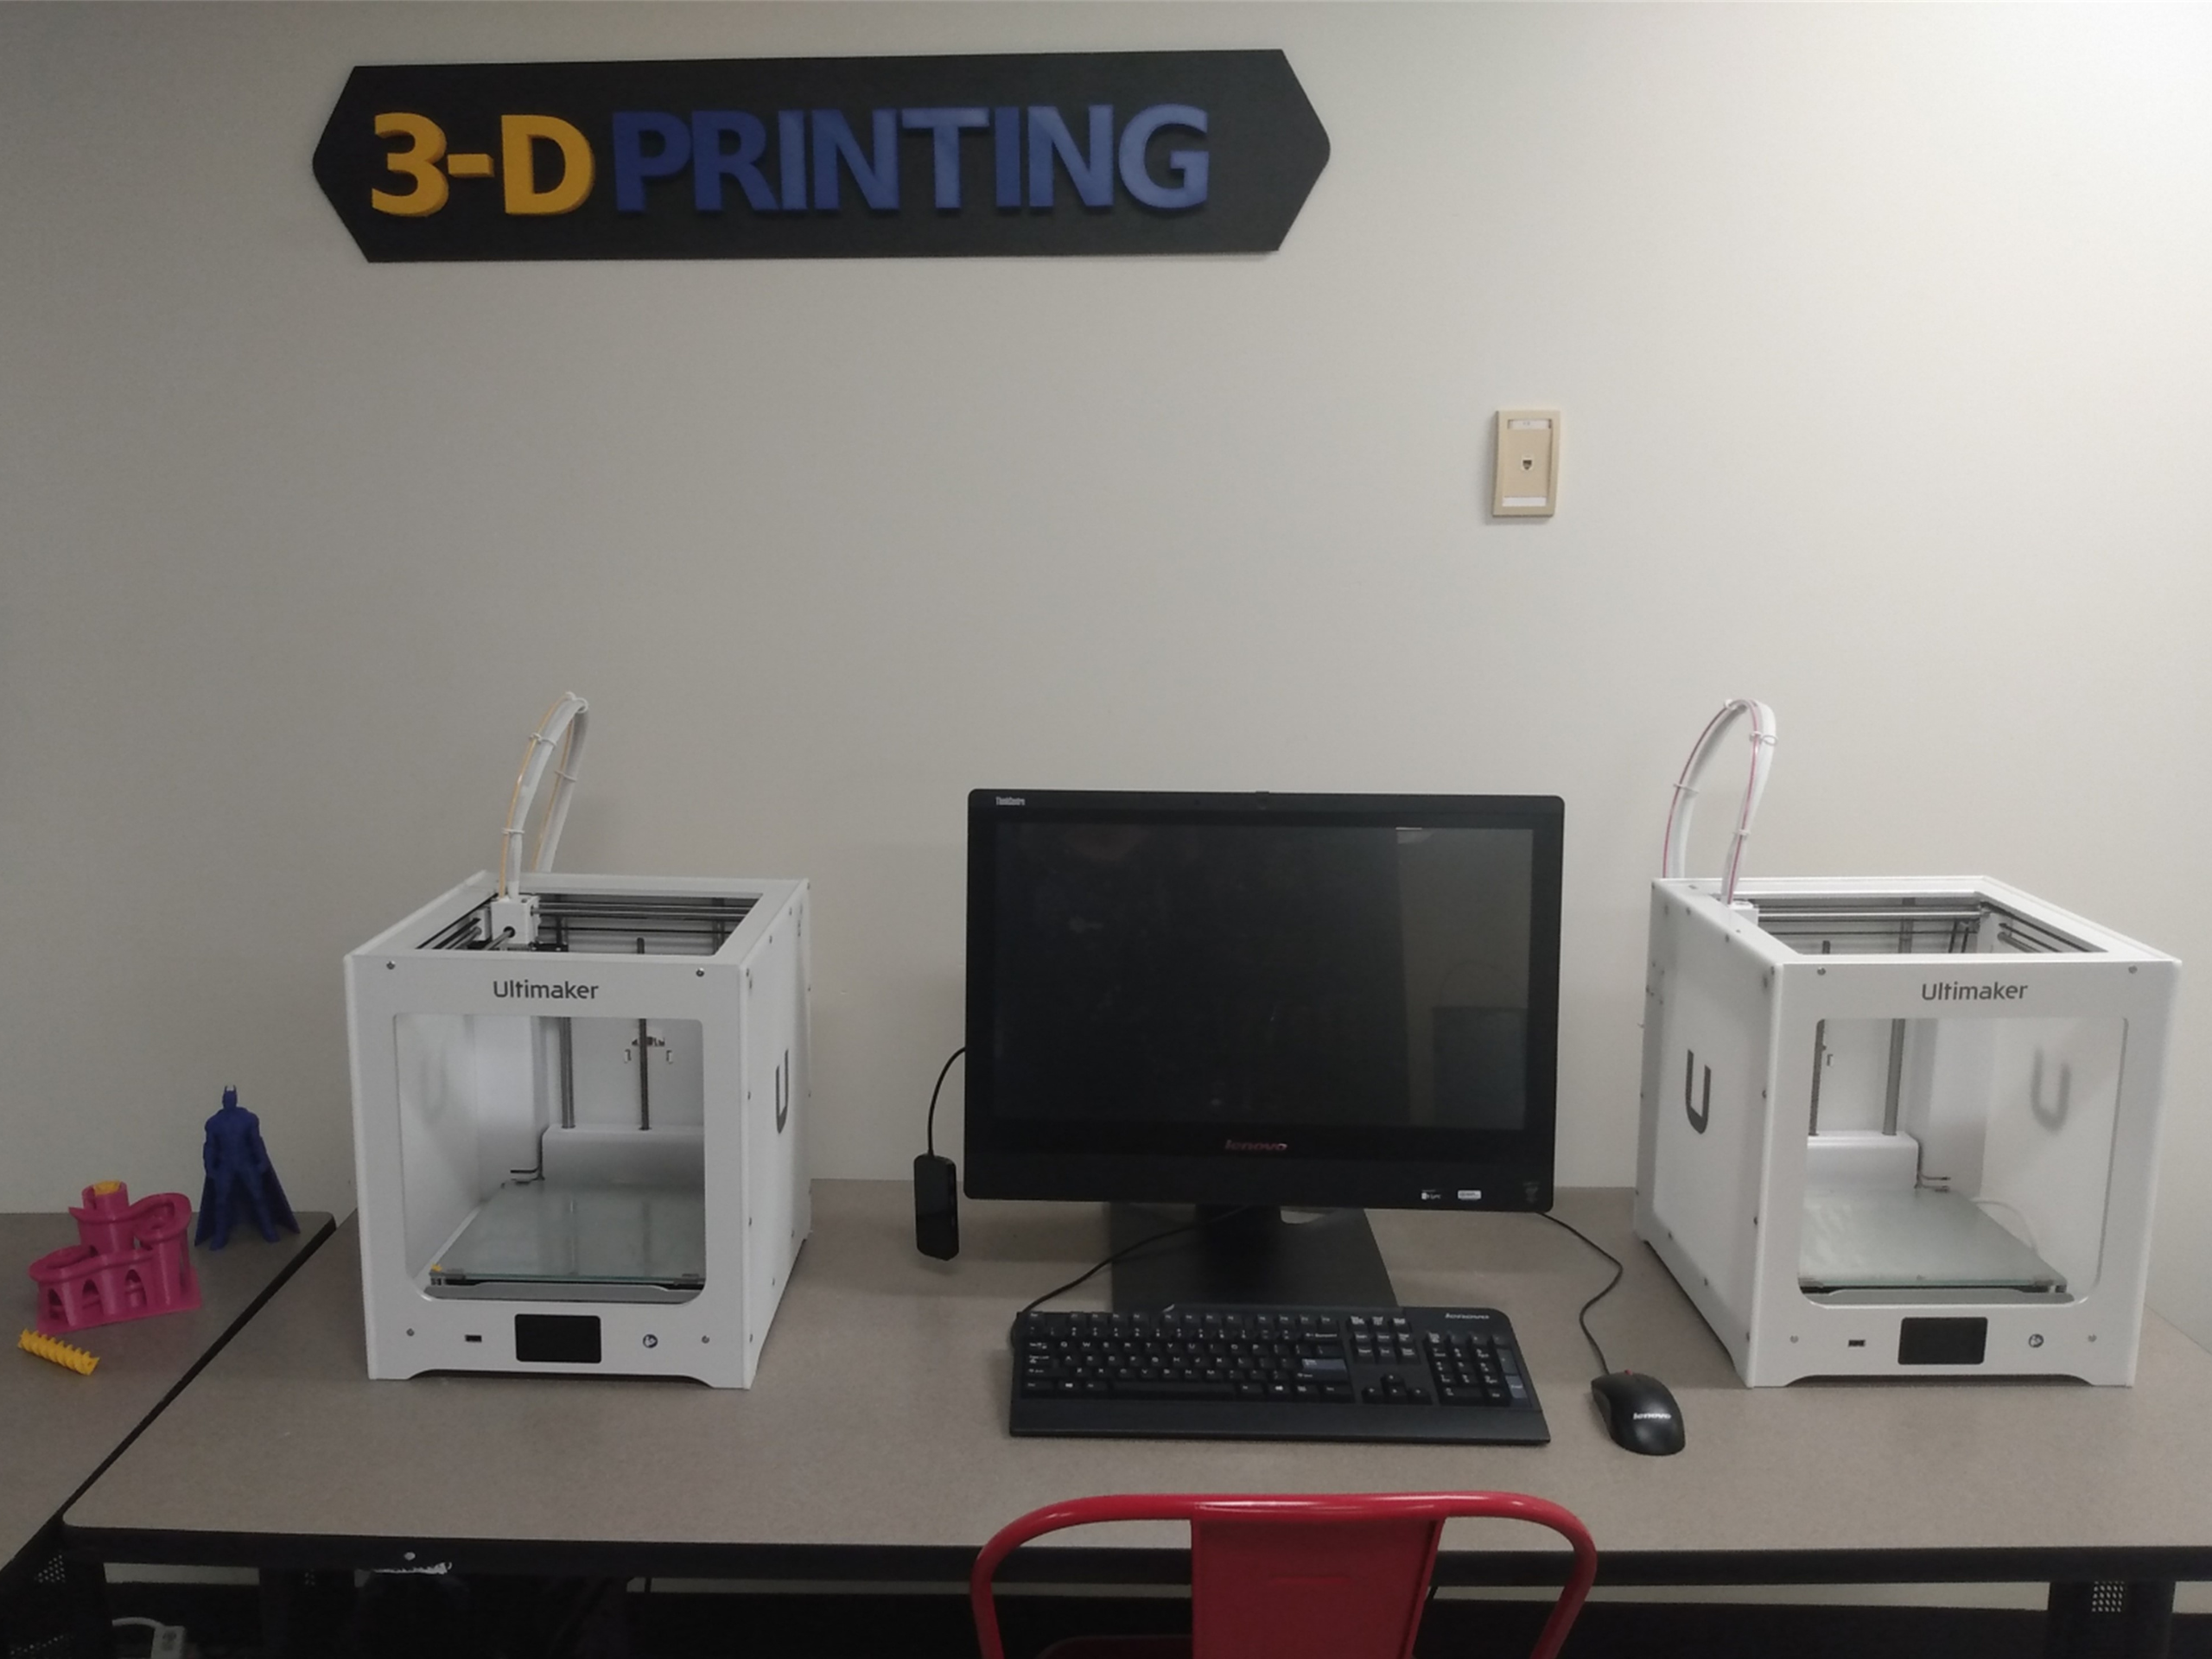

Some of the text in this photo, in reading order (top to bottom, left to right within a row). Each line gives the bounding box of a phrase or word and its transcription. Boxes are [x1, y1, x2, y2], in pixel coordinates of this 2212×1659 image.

[370, 103, 1211, 217] 3-D PRINTING
[493, 979, 600, 1000] Ultimaker
[1921, 981, 2029, 1001] Ultimaker
